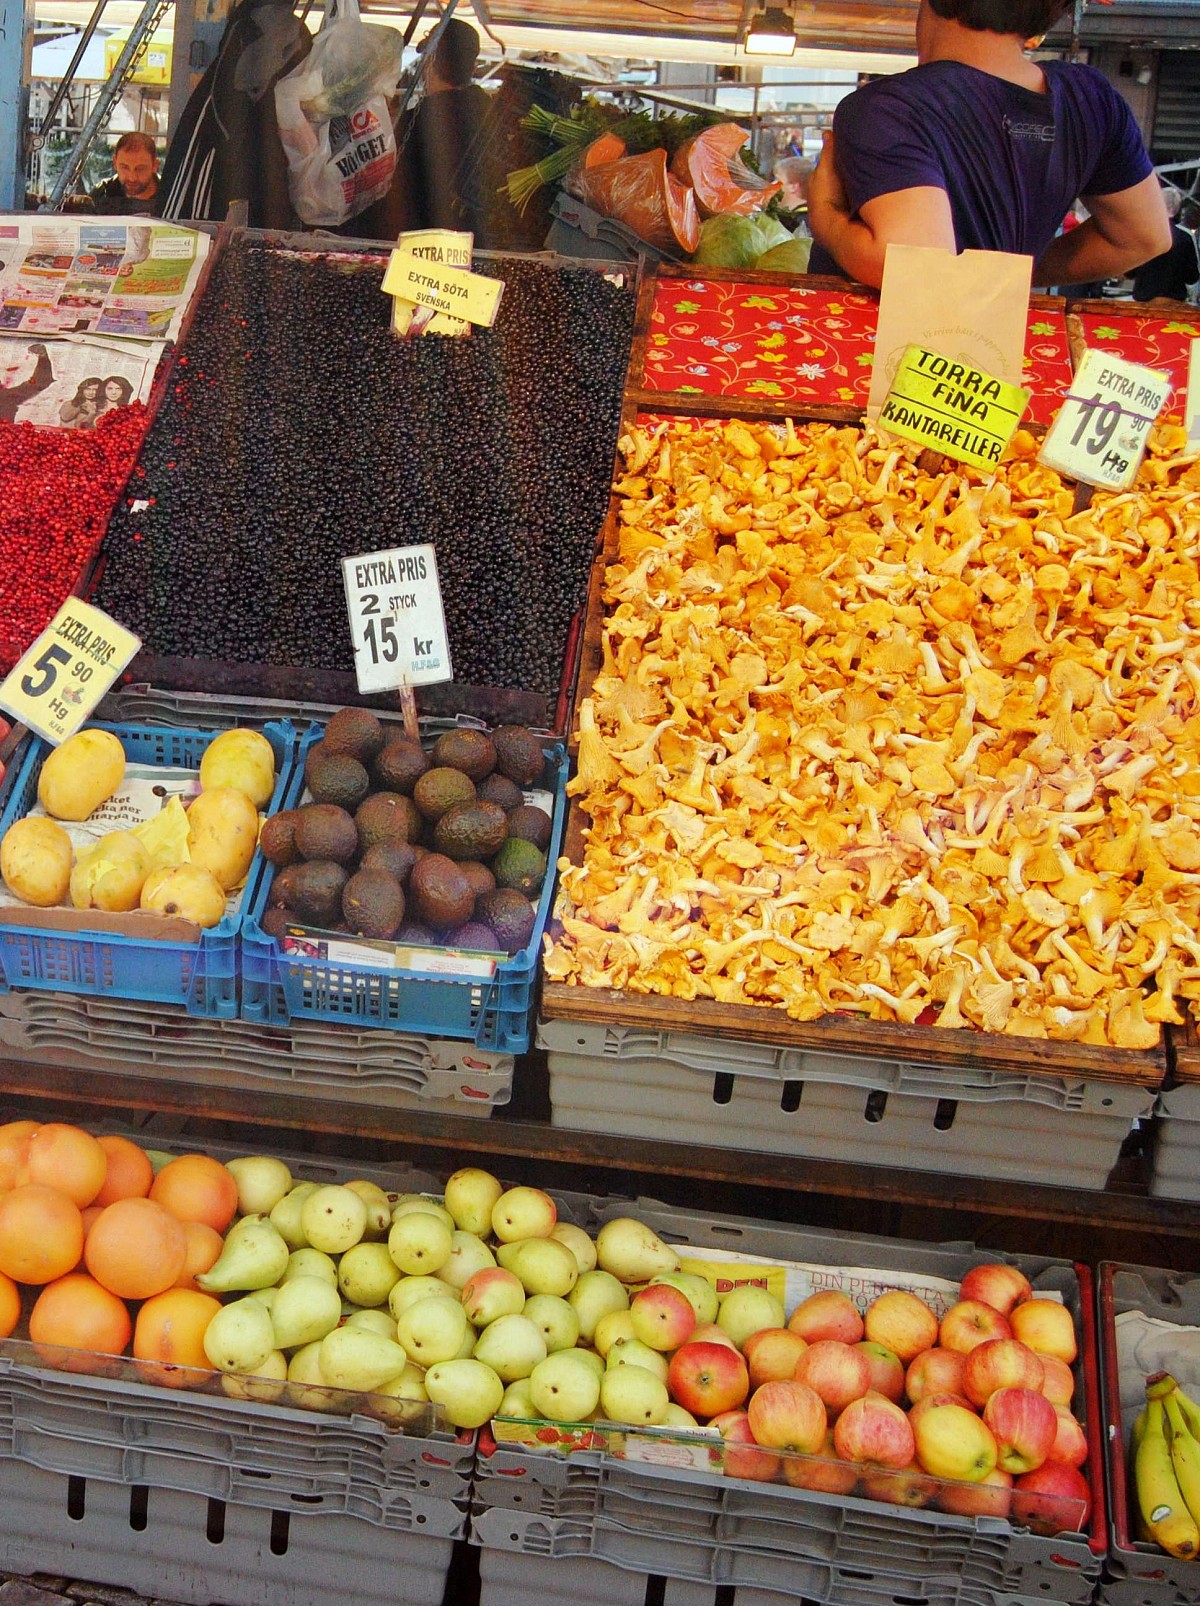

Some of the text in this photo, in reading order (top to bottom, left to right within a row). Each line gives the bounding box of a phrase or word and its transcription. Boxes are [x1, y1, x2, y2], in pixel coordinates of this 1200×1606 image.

[446, 248, 469, 264] PRIS
[408, 272, 468, 299] EXTRA SÖTA
[416, 292, 451, 310] SVENSKA
[918, 350, 1001, 400] TORRA
[1097, 369, 1162, 411] EXTRA PRIS
[882, 401, 1002, 462] KANTARELLER
[1069, 393, 1146, 455] 19 90
[355, 556, 427, 589] EXTRA PRIS
[360, 594, 417, 616] 2 STYCK
[56, 616, 116, 666] EXTRA PRIS
[363, 616, 433, 664] 15 kr
[21, 643, 94, 697] 5 90
[48, 698, 69, 720] Hg
[811, 1271, 843, 1290] DIN
